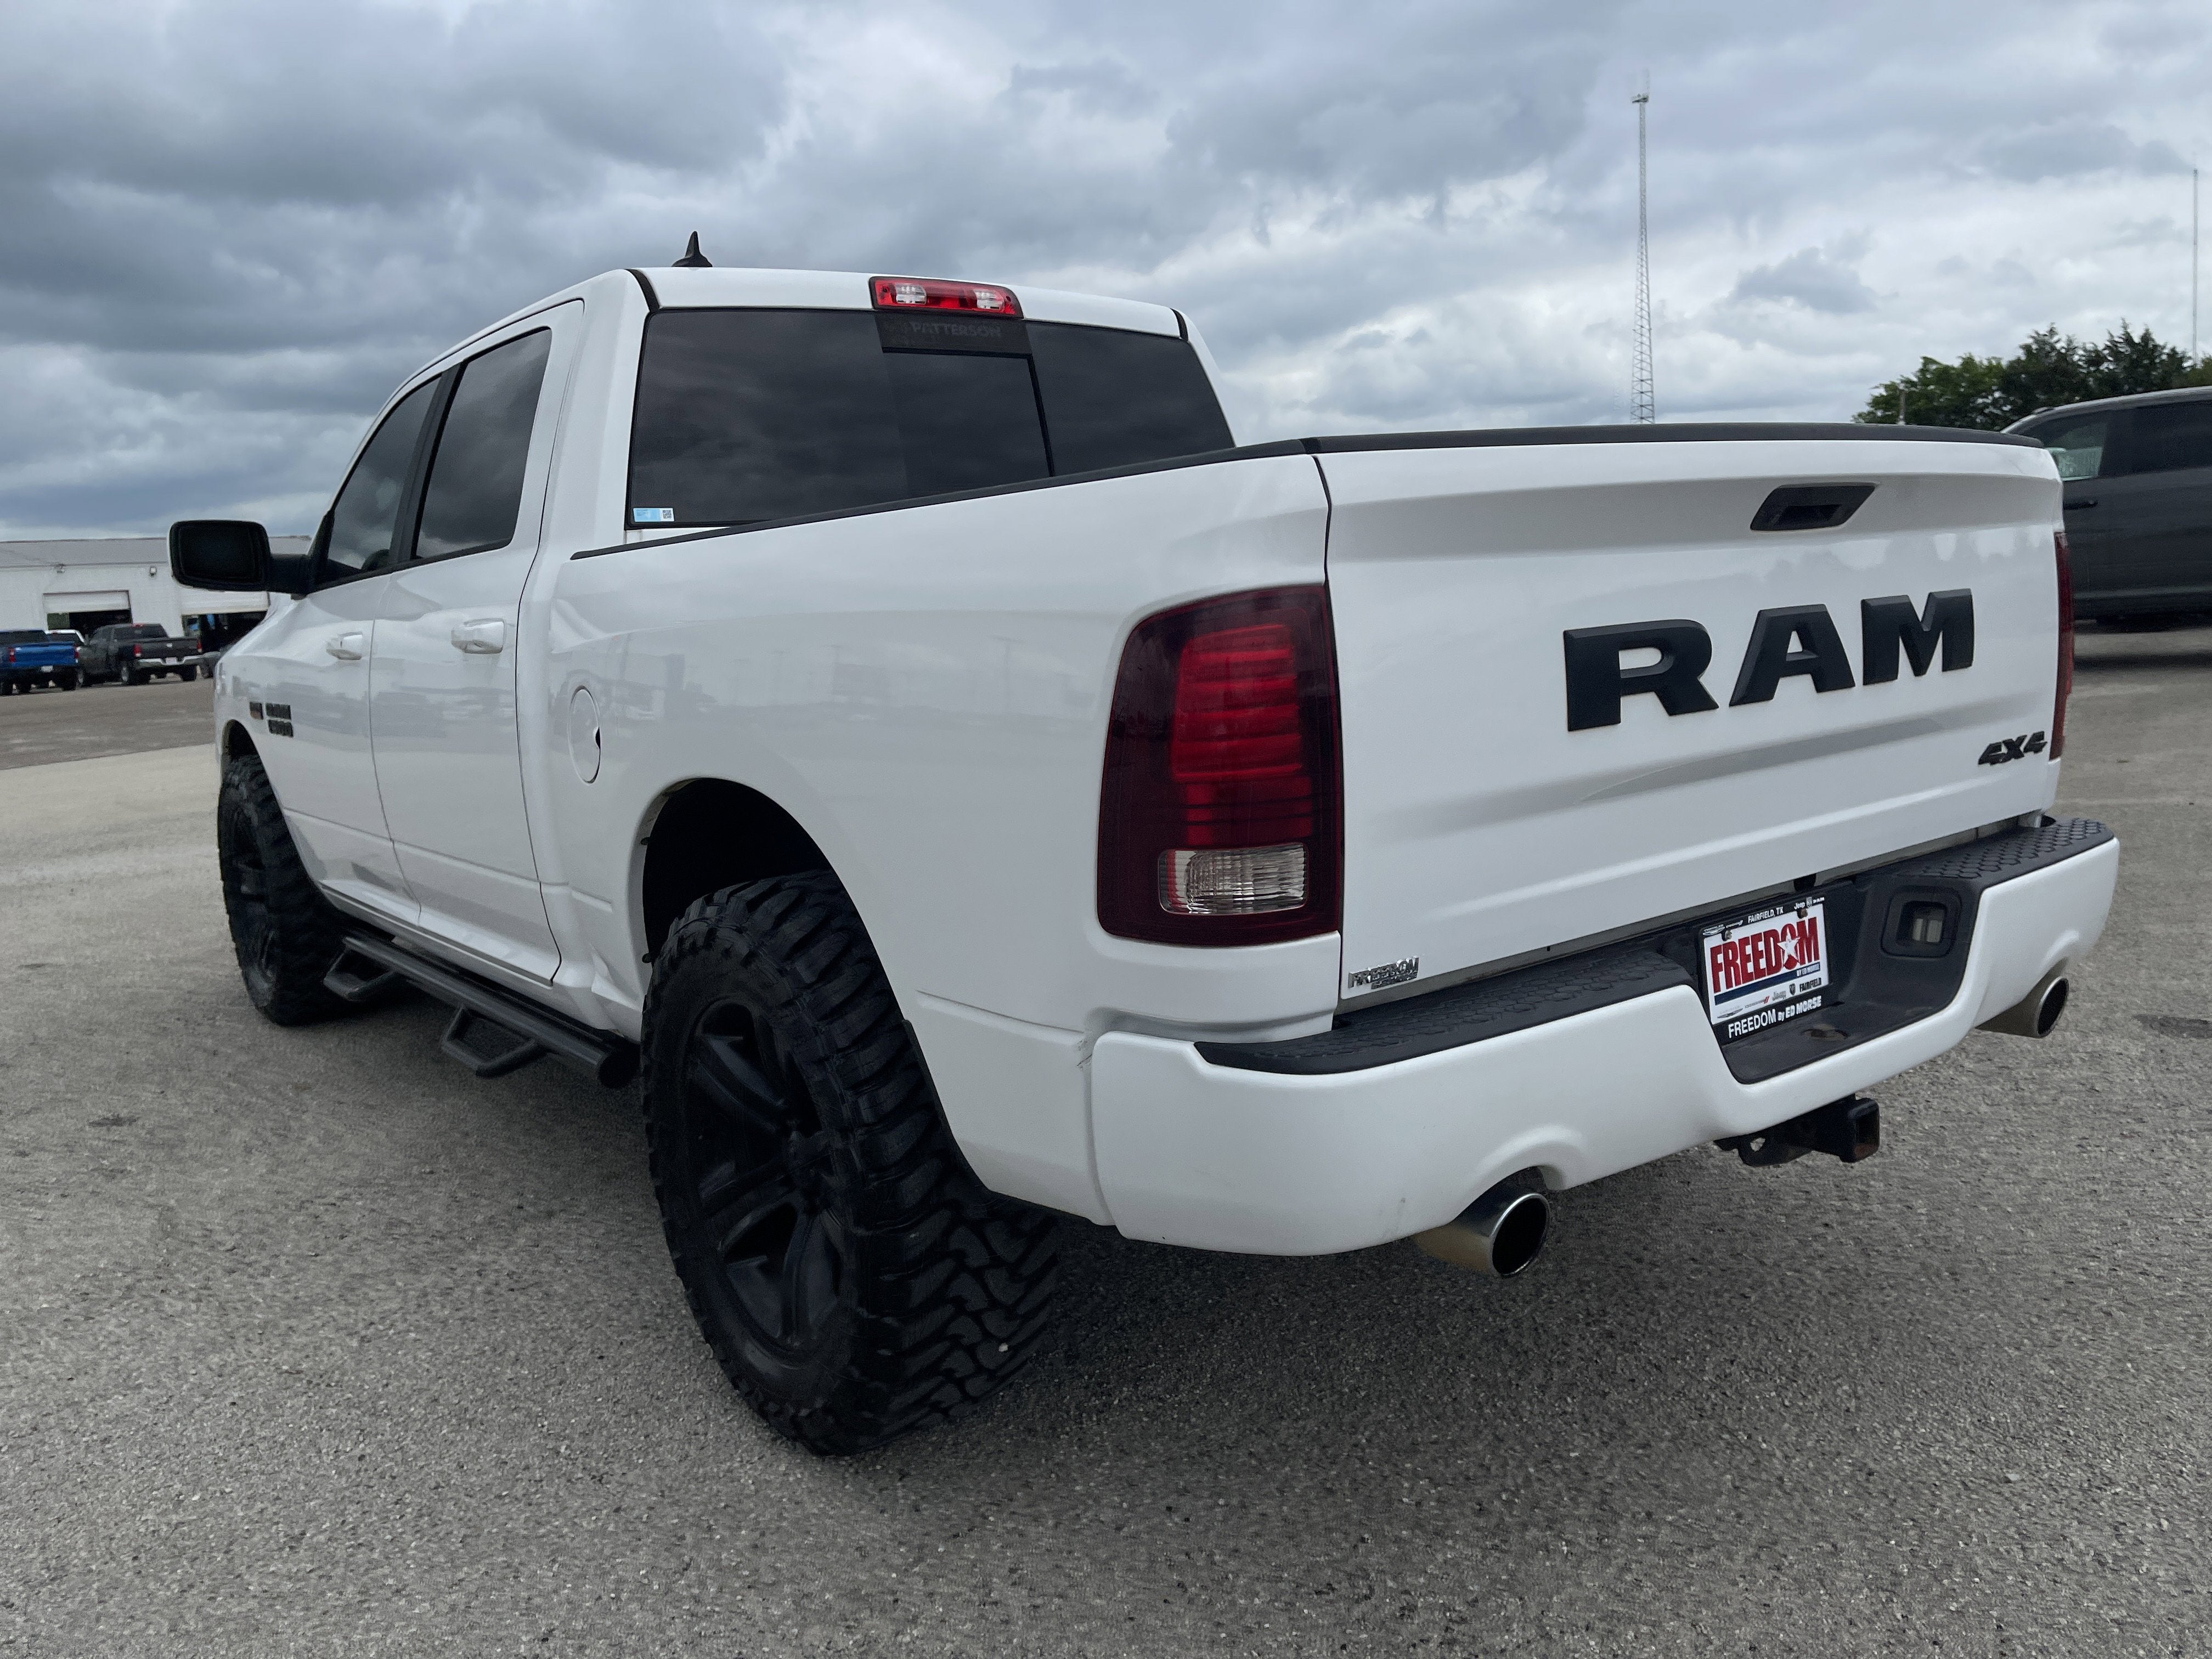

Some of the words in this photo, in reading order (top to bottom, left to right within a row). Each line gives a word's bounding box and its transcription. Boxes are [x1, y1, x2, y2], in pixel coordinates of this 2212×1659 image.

[1564, 588, 1974, 732] RAM
[1710, 917, 1820, 994] FREEDOM
[1728, 1009, 1776, 1038] FREEDOM
[1785, 1005, 1795, 1018] ED
[1796, 995, 1821, 1014] MORSE
